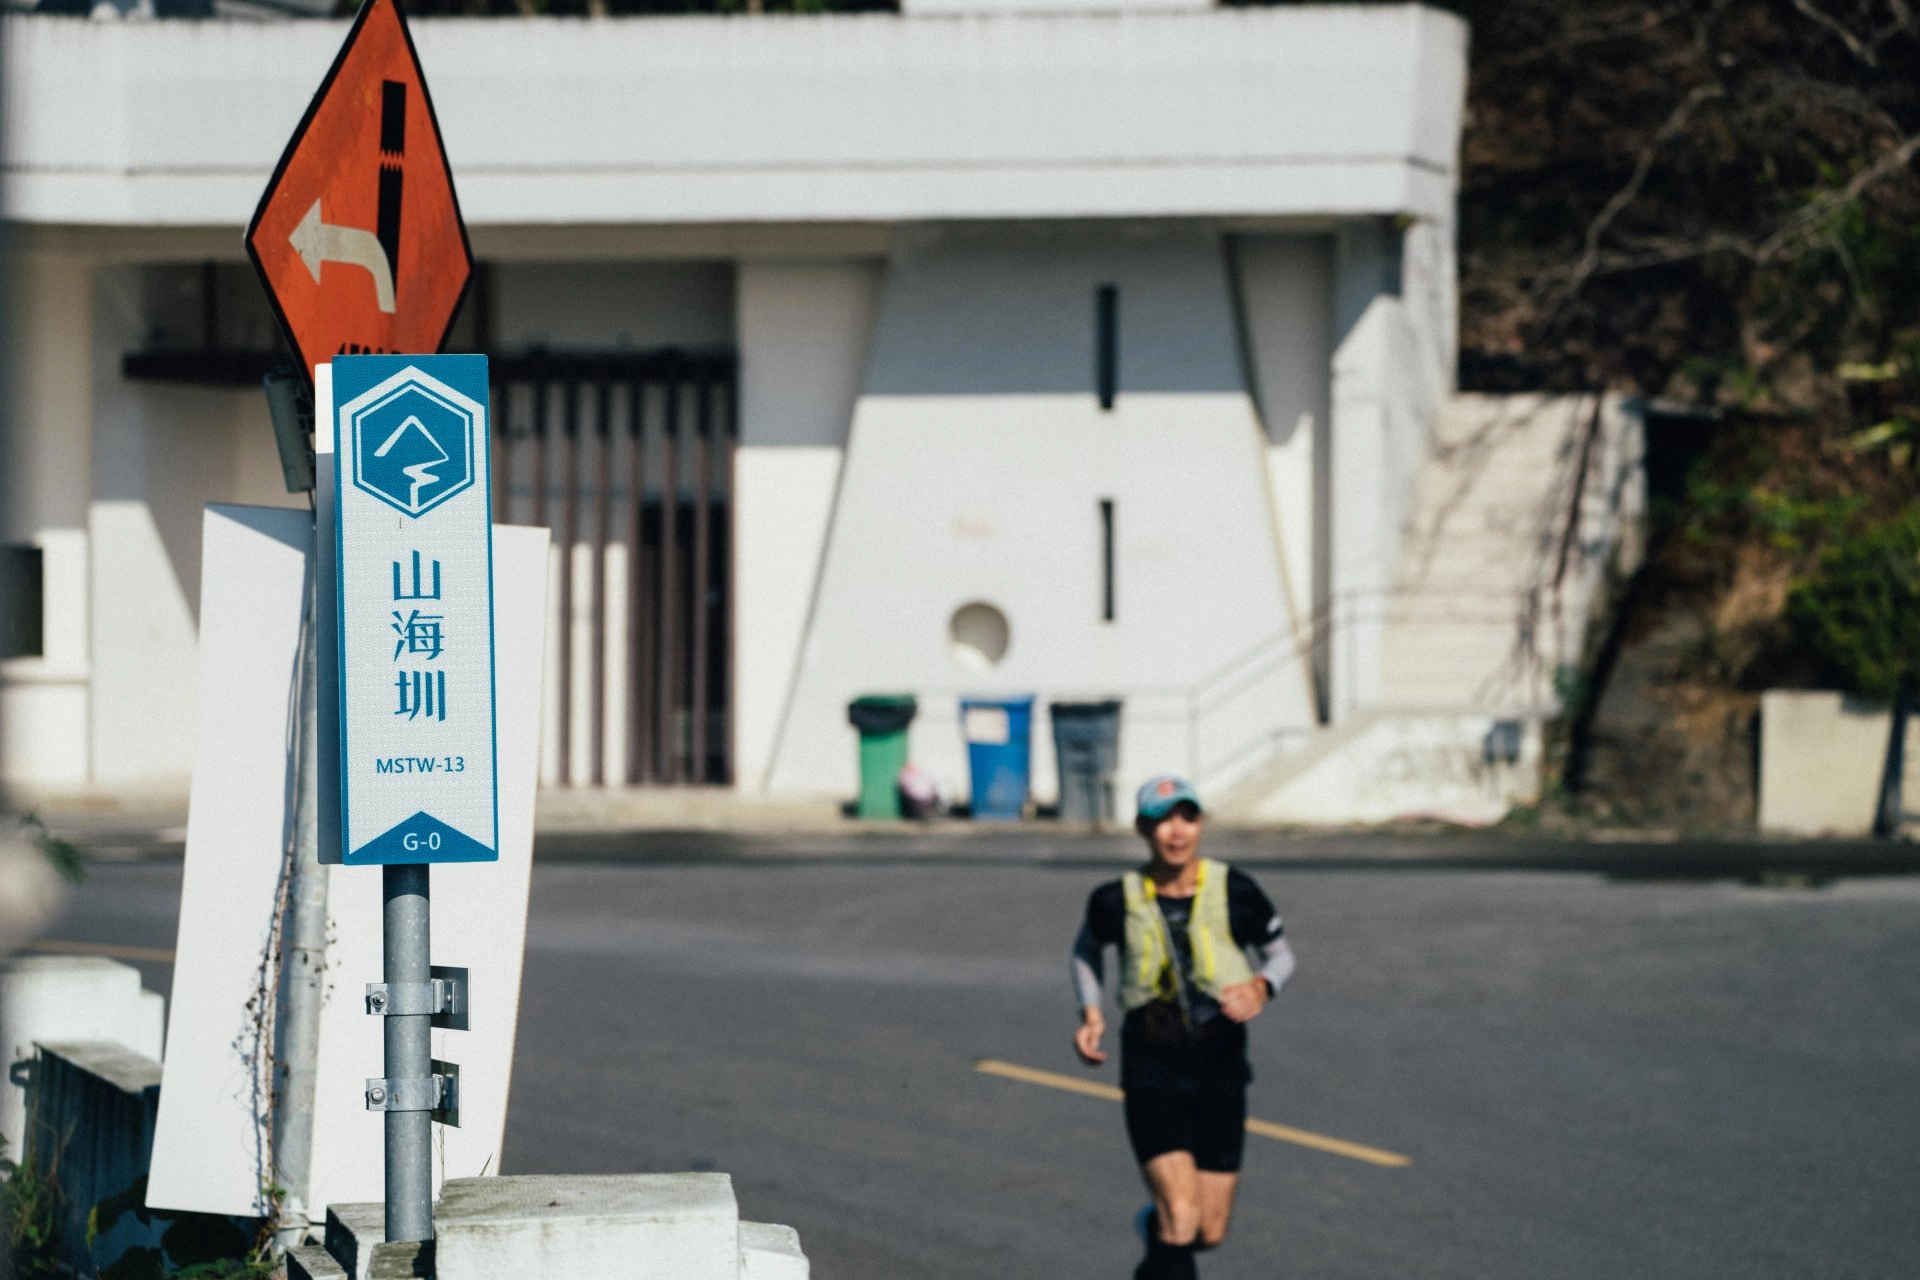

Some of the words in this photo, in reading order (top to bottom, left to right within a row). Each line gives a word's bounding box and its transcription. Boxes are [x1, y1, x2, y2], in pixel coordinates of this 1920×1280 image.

[391, 550, 446, 722] 山海圳
[376, 756, 465, 774] MSTW-13
[402, 832, 441, 851] G-0
